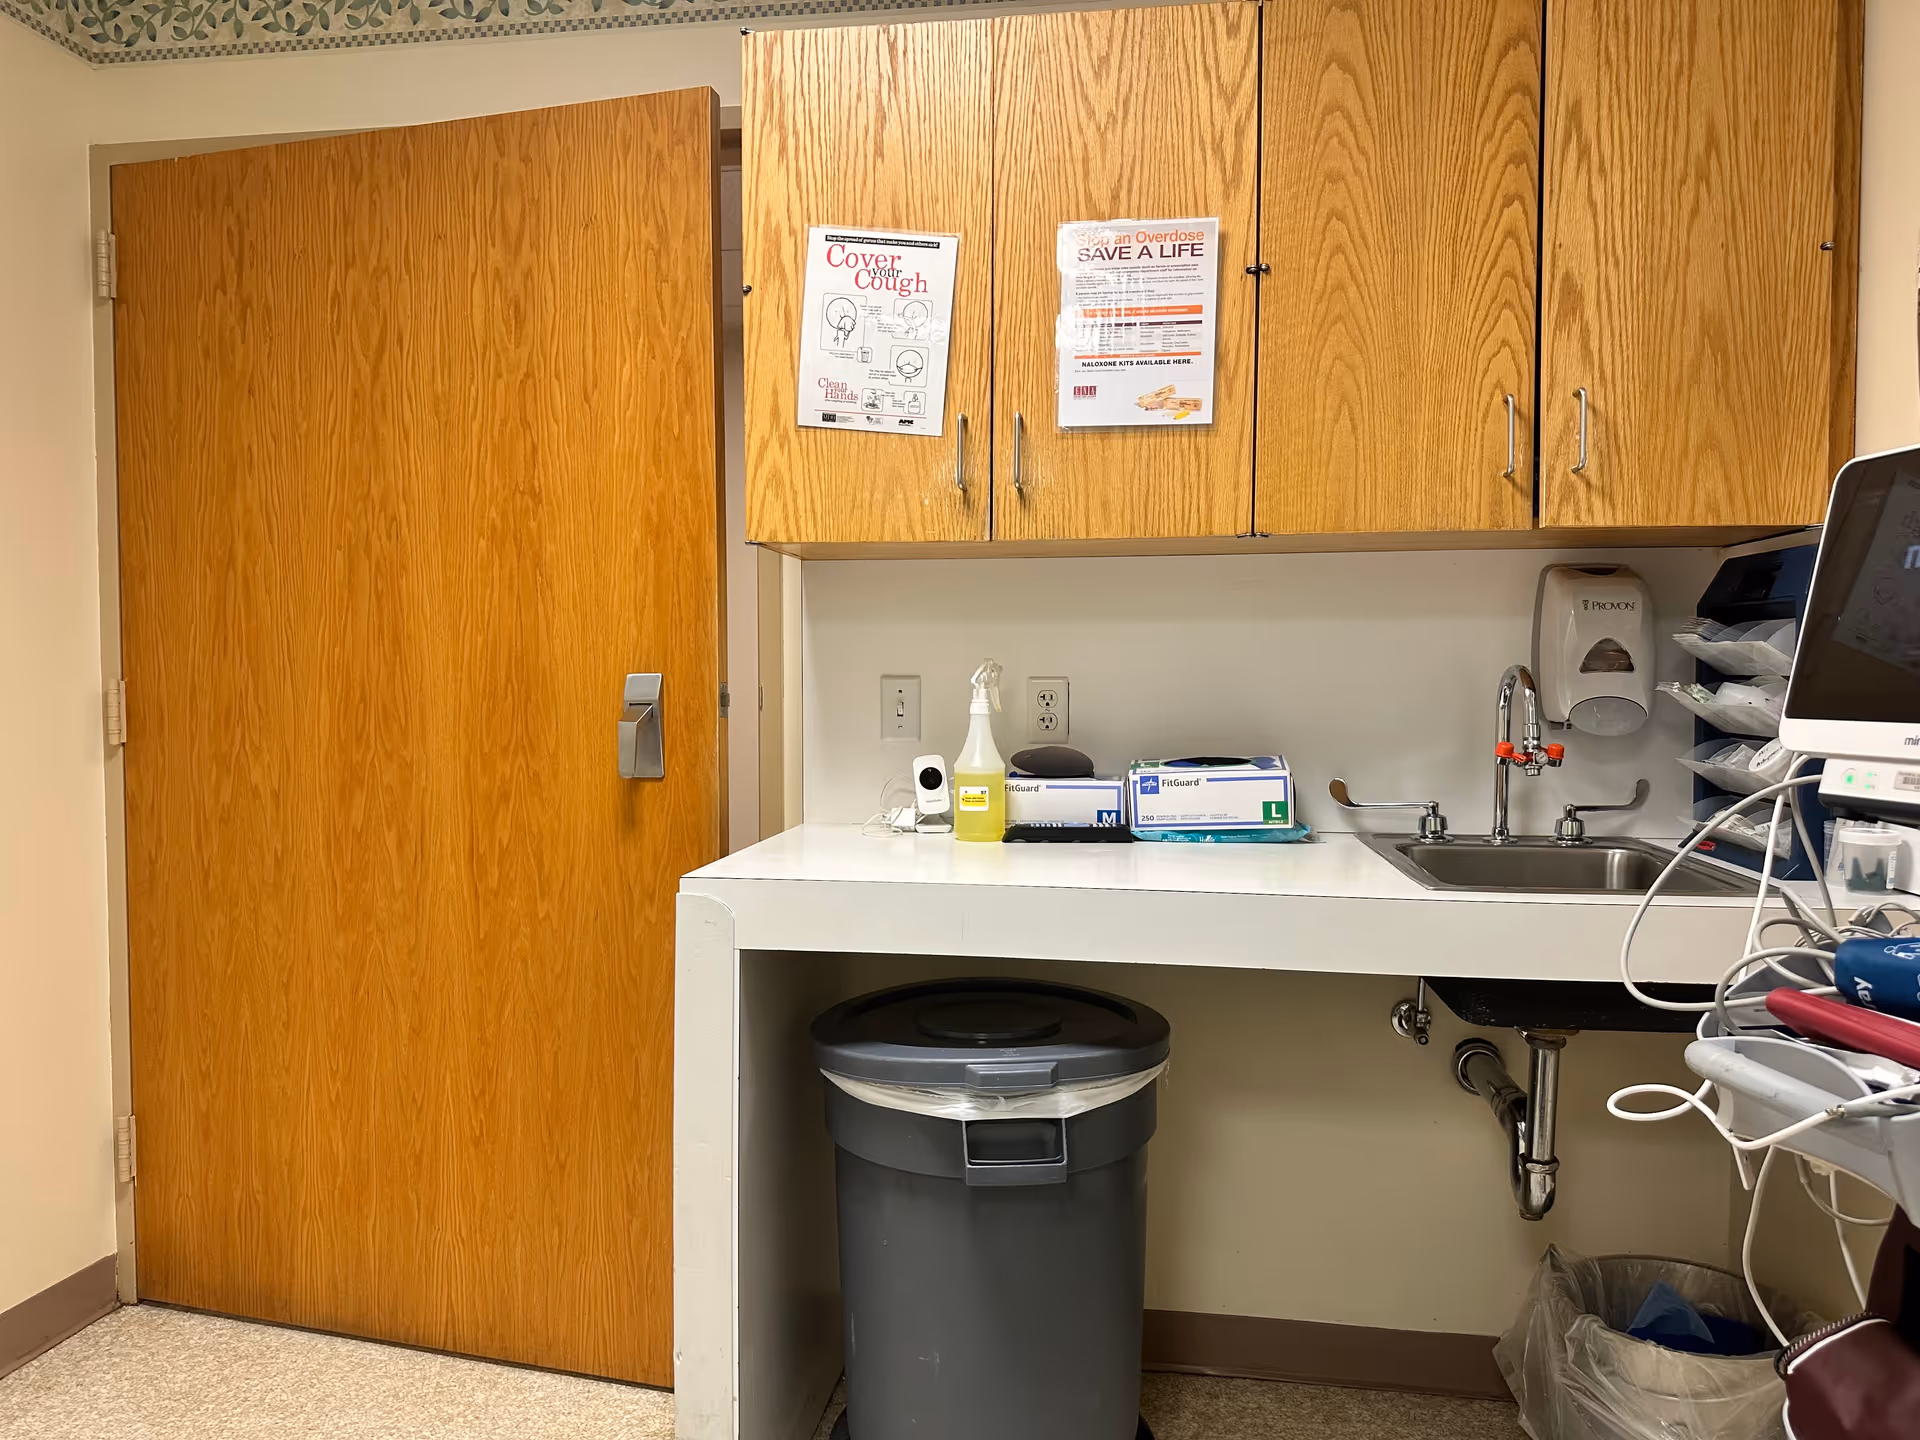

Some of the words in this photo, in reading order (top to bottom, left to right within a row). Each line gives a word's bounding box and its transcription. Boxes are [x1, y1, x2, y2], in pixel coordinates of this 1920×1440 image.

[1114, 234, 1131, 245] an
[1135, 229, 1205, 244] Overdose
[826, 243, 902, 270] Cover
[1077, 245, 1132, 262] SAVE
[1137, 244, 1153, 260] A
[1160, 242, 1204, 259] LIFE
[872, 268, 902, 279] your
[854, 268, 928, 297] Cough
[818, 377, 848, 389] Clean
[824, 388, 859, 401] Hands
[1005, 783, 1039, 793] FitGuard
[1162, 777, 1200, 788] FitGuard
[1271, 803, 1282, 818] L
[1102, 811, 1117, 824] M
[1141, 814, 1155, 822] 250
